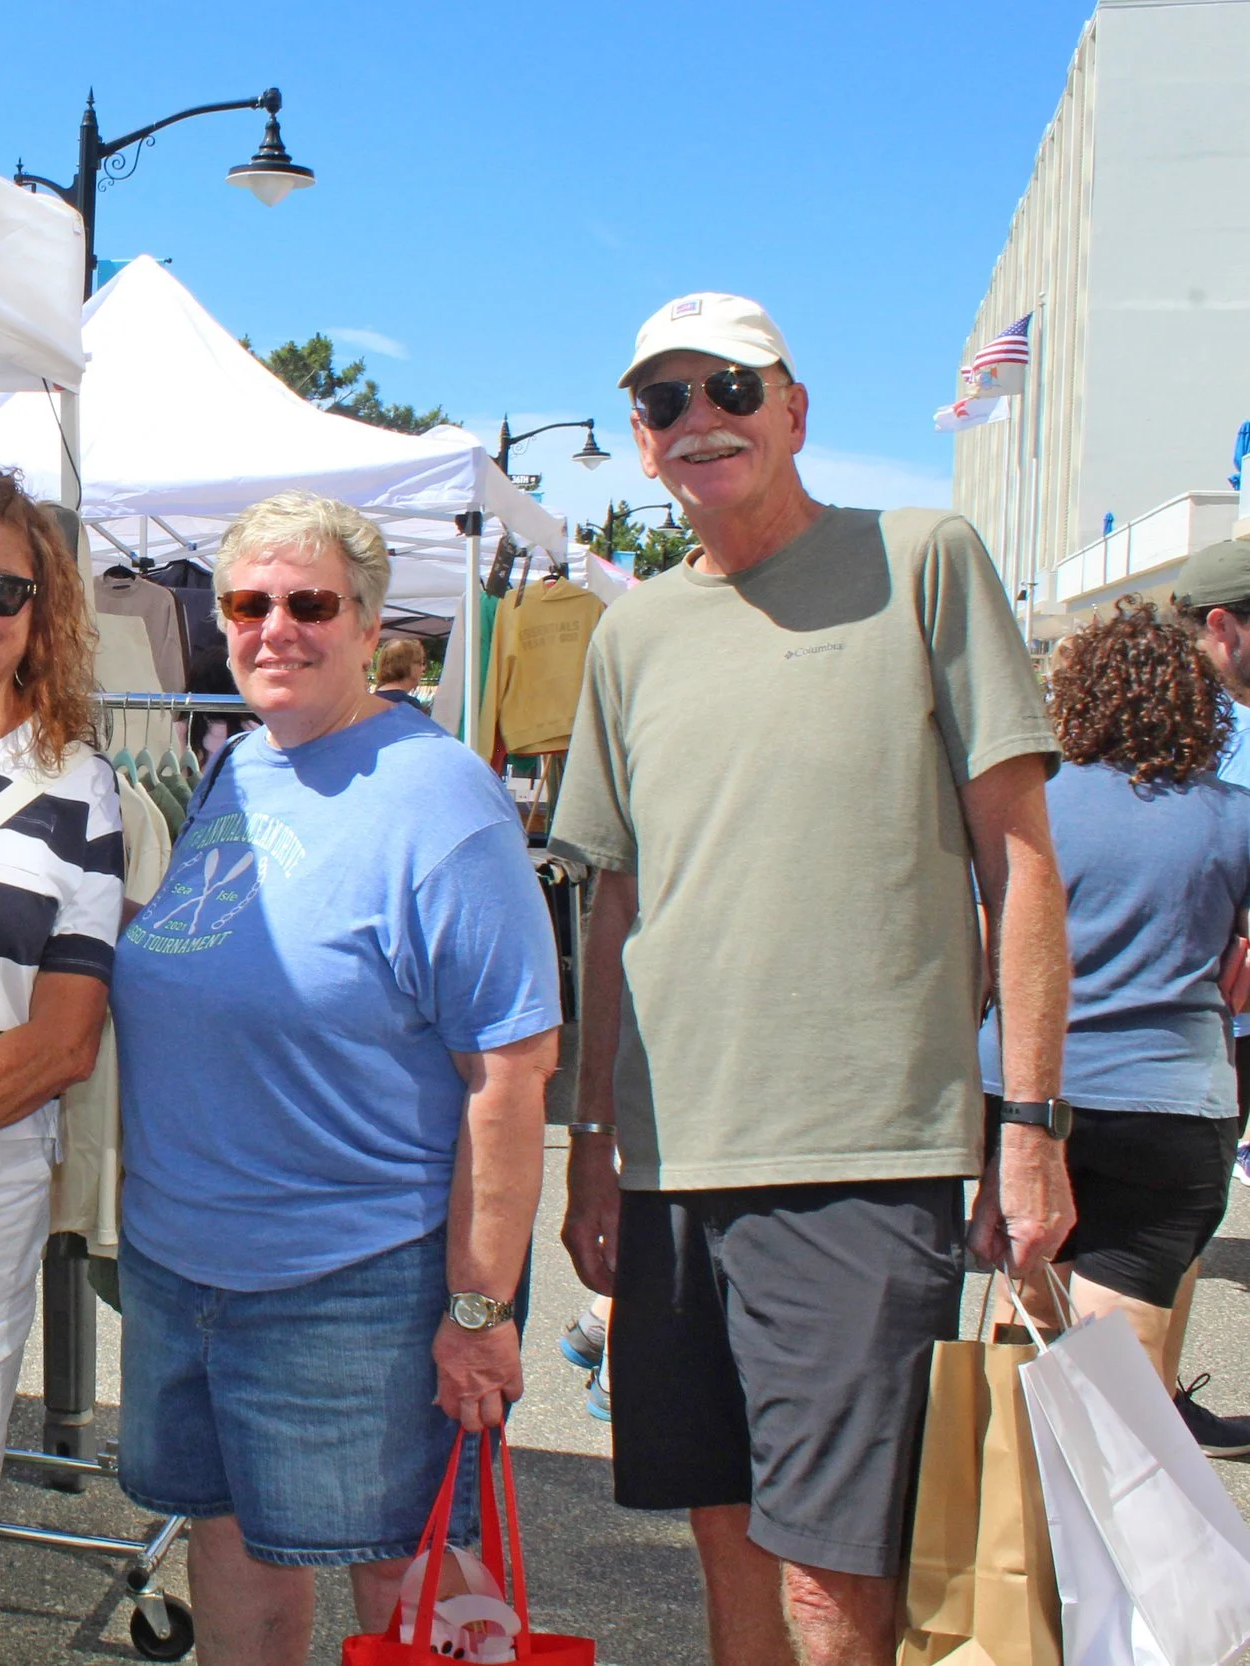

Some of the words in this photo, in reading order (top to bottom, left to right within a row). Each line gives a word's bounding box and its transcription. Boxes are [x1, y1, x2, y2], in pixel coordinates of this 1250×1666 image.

[794, 642, 845, 658] Columbia
[171, 883, 192, 895] Sea
[216, 890, 238, 902] Isle
[164, 920, 188, 932] 2021
[143, 930, 233, 955] TOURNAMENT
